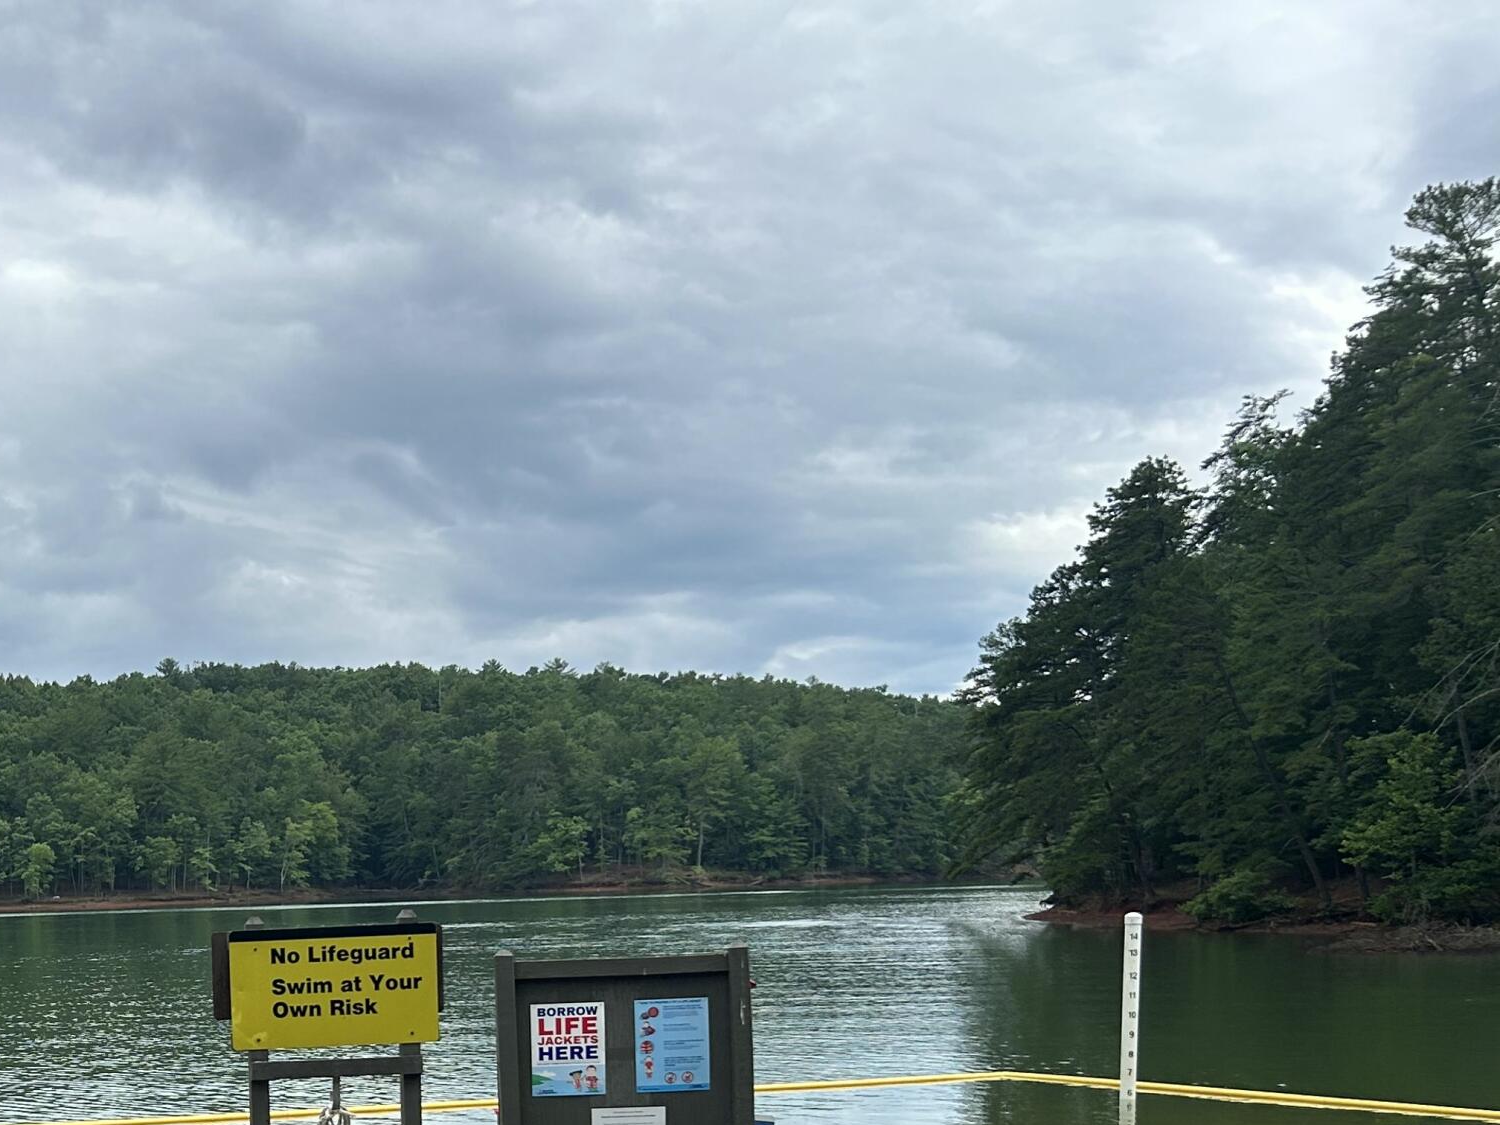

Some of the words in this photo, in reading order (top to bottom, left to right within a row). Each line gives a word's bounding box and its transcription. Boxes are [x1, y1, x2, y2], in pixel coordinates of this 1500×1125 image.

[1129, 932, 1138, 940] 14
[270, 948, 300, 964] No
[308, 942, 414, 964] Lifeguard
[1129, 949, 1138, 957] 13
[1129, 972, 1138, 980] 12
[272, 978, 333, 995] Swim
[341, 976, 362, 992] at
[369, 974, 422, 991] Your
[1129, 991, 1136, 999] 11
[272, 1001, 322, 1018] Own
[330, 998, 378, 1016] Risk
[537, 1006, 597, 1017] BORROW
[538, 1017, 598, 1035] LIFE
[537, 1035, 598, 1045] JACKETS
[538, 1045, 598, 1061] HERE
